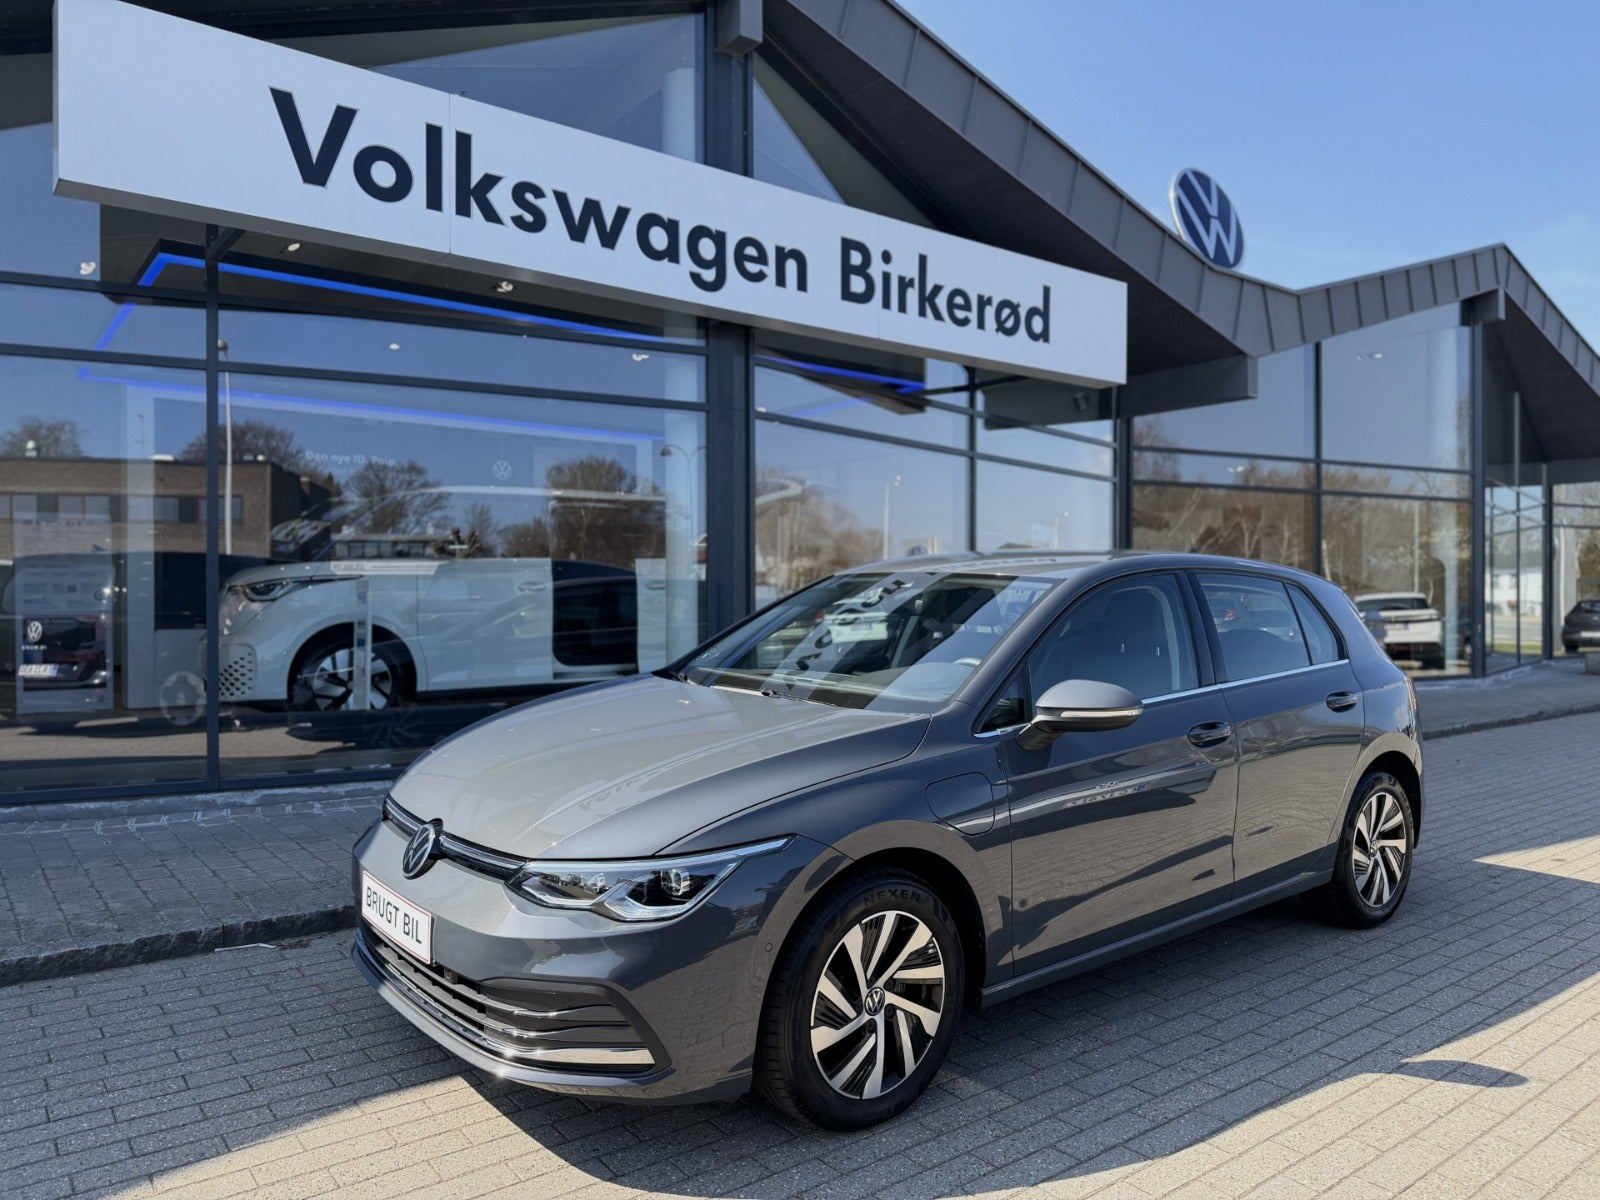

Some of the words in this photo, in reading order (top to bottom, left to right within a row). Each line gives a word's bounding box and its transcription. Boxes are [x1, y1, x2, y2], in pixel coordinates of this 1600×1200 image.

[269, 86, 808, 293] Volkswagen
[840, 236, 1051, 344] Birkerød
[1173, 168, 1243, 268] VW
[366, 886, 399, 928] BRUGT
[403, 912, 422, 945] BIL
[864, 888, 921, 904] NEXEN
